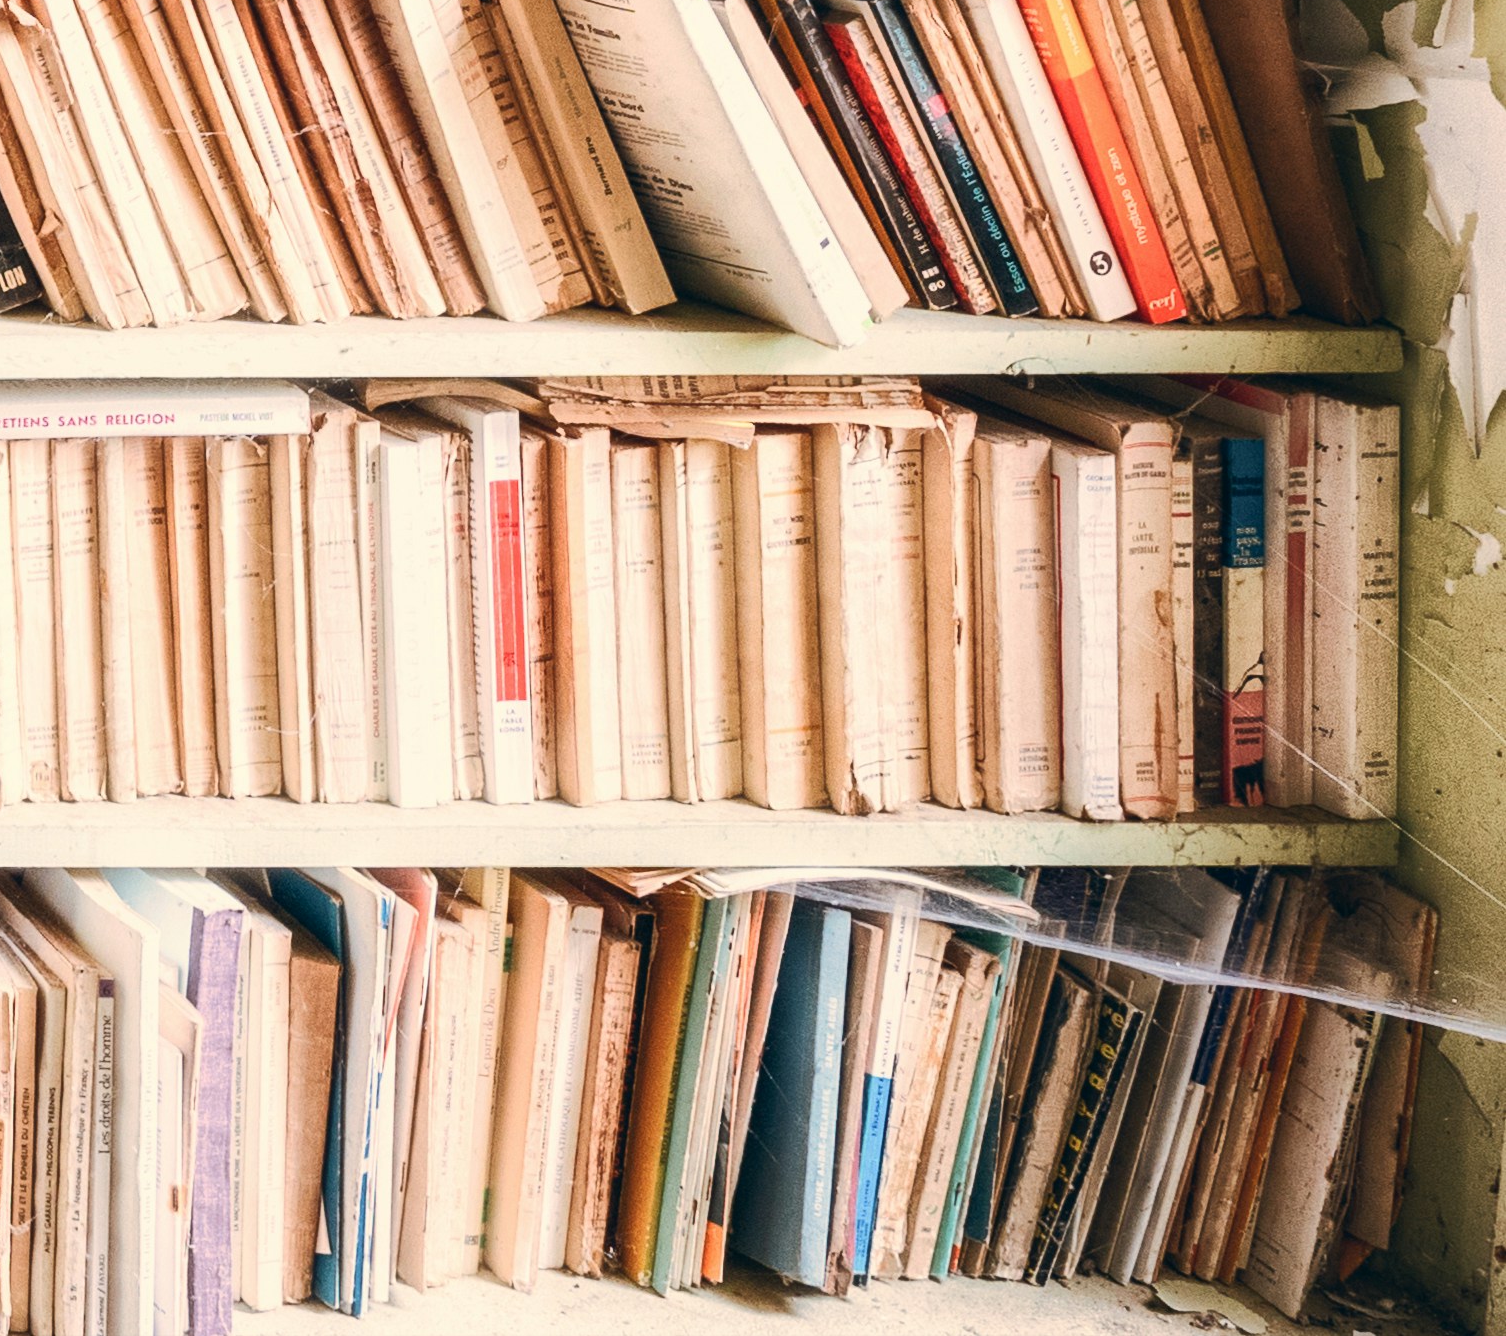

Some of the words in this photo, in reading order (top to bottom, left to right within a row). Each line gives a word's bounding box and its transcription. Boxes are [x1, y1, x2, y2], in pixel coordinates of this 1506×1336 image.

[952, 142, 982, 185] l'Église
[1107, 147, 1125, 171] zen
[1115, 172, 1127, 185] et
[972, 187, 989, 202] de
[983, 206, 1005, 240] déclin
[1119, 188, 1150, 245] mystique
[997, 242, 1012, 257] ou
[1008, 260, 1027, 293] Essor
[1149, 288, 1176, 310] cerf
[98, 1015, 113, 1071] l'homme
[99, 1074, 111, 1089] de
[97, 1092, 112, 1128] droits
[97, 1132, 112, 1154] Les
